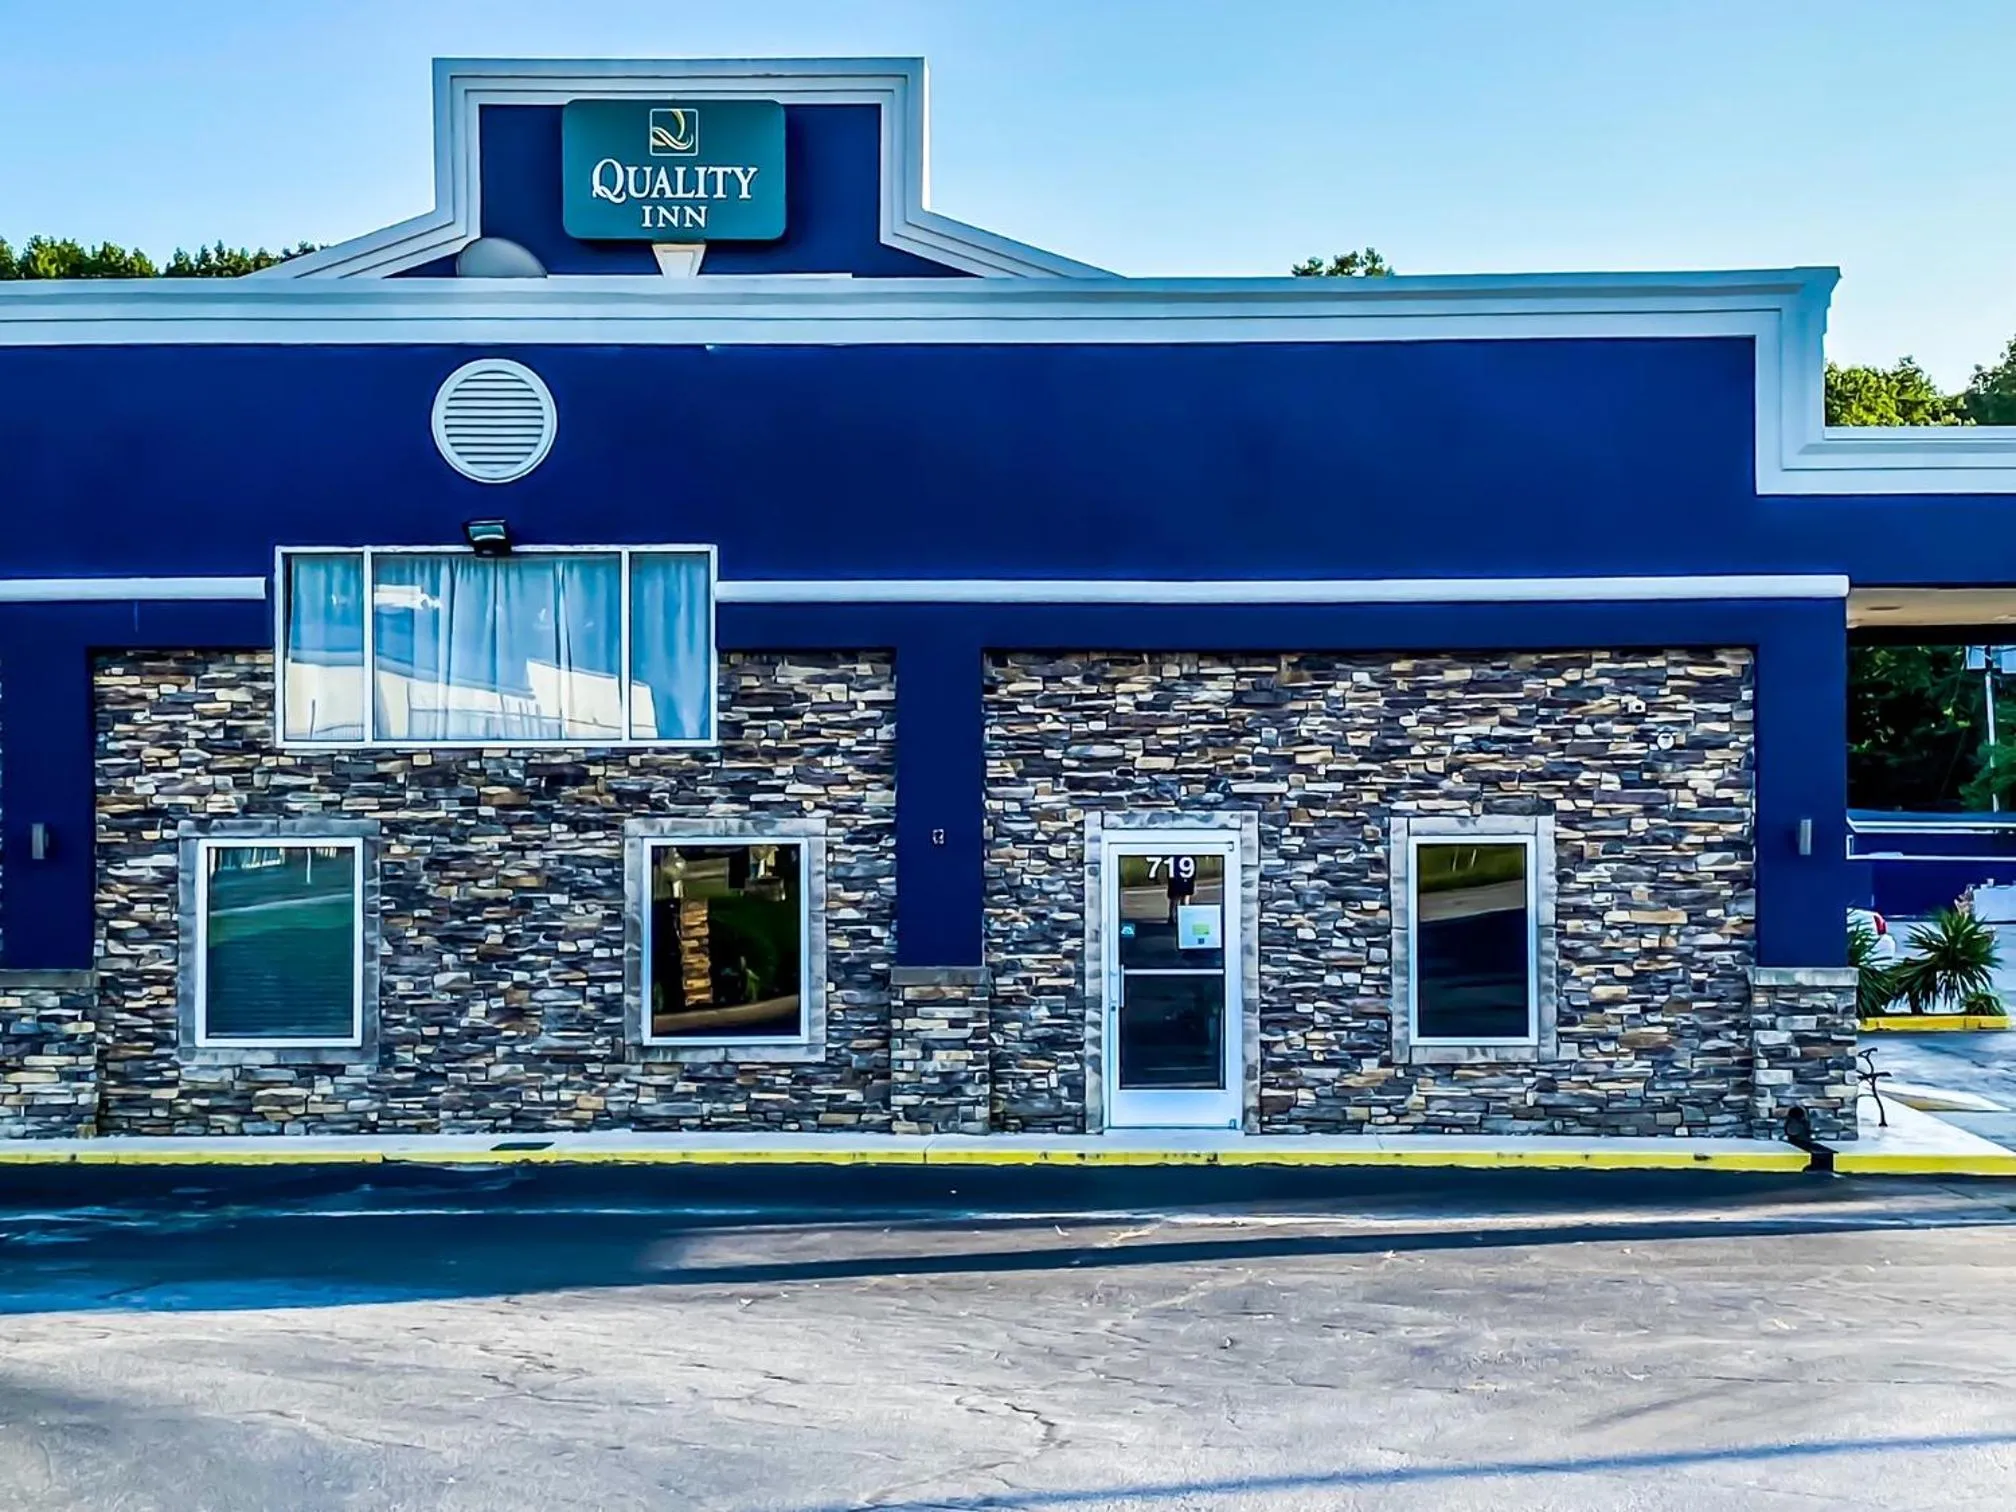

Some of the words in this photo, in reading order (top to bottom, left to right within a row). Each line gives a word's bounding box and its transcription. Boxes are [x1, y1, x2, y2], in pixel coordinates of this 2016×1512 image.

[591, 158, 758, 204] QUALITY
[641, 205, 708, 228] INN
[1146, 856, 1196, 879] 719
